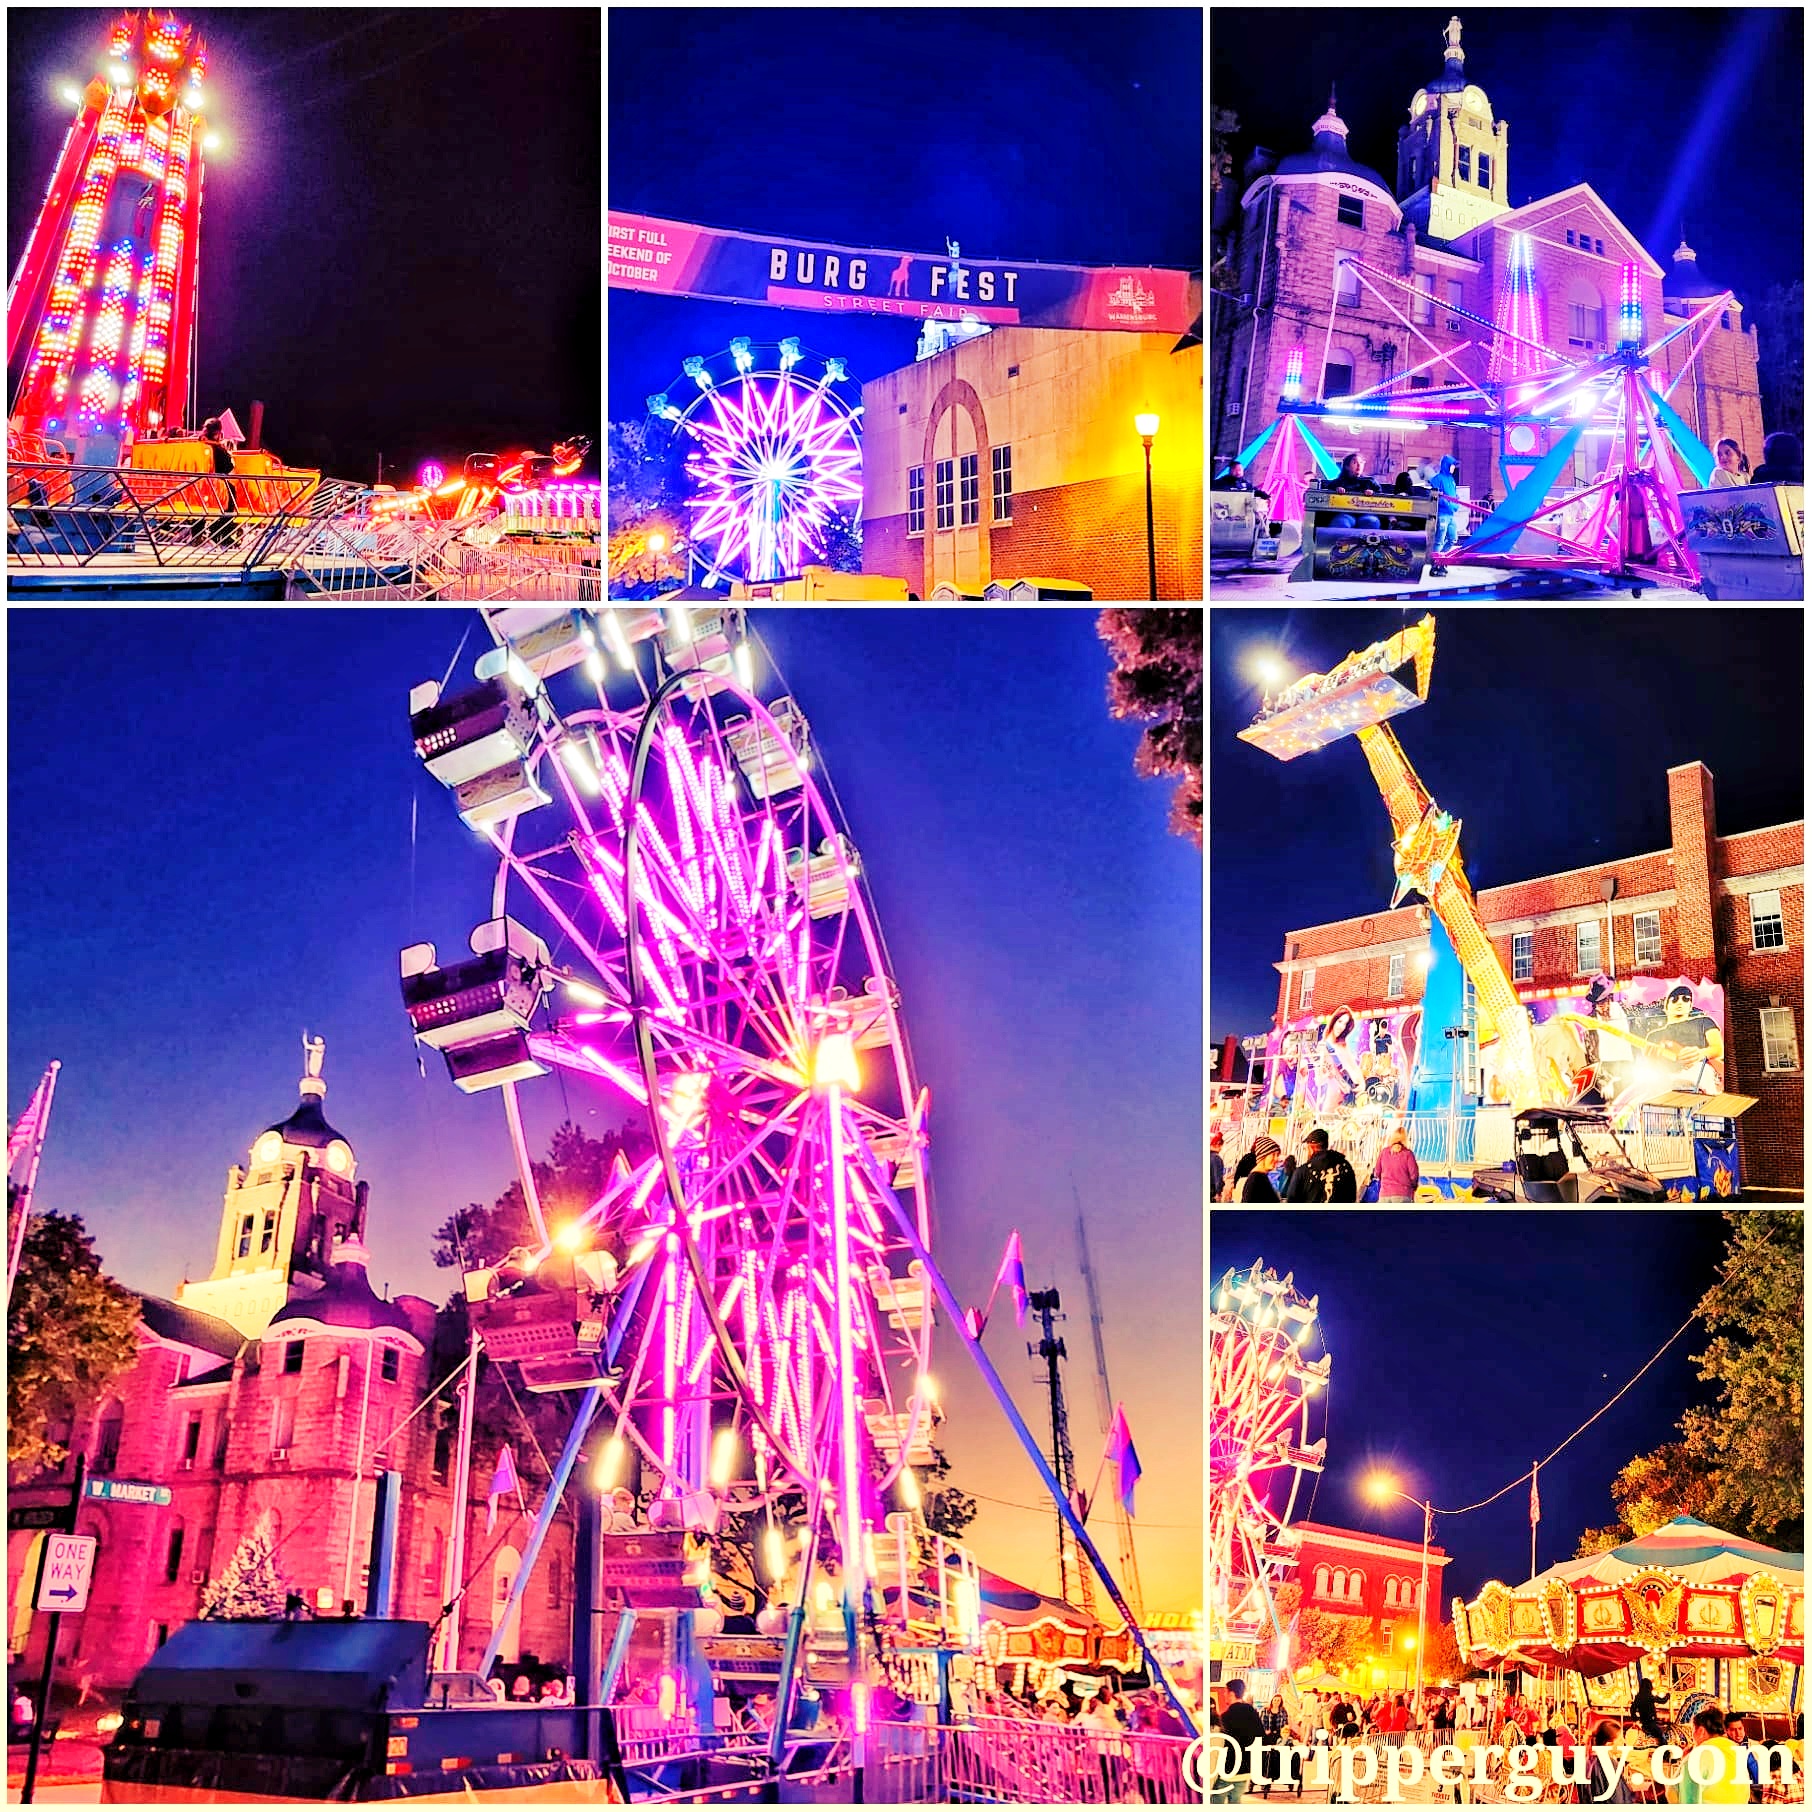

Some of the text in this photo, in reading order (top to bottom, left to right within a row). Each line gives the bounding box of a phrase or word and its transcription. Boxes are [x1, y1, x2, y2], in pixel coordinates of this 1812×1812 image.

[608, 224, 668, 246] IRST FULL
[655, 251, 673, 264] OF
[770, 248, 1018, 302] BURG FEST
[823, 295, 905, 312] STREET
[110, 1483, 157, 1501] MARKET
[55, 1542, 88, 1560] ONE
[51, 1563, 86, 1580] WAY
[1226, 1645, 1252, 1660] ATM
